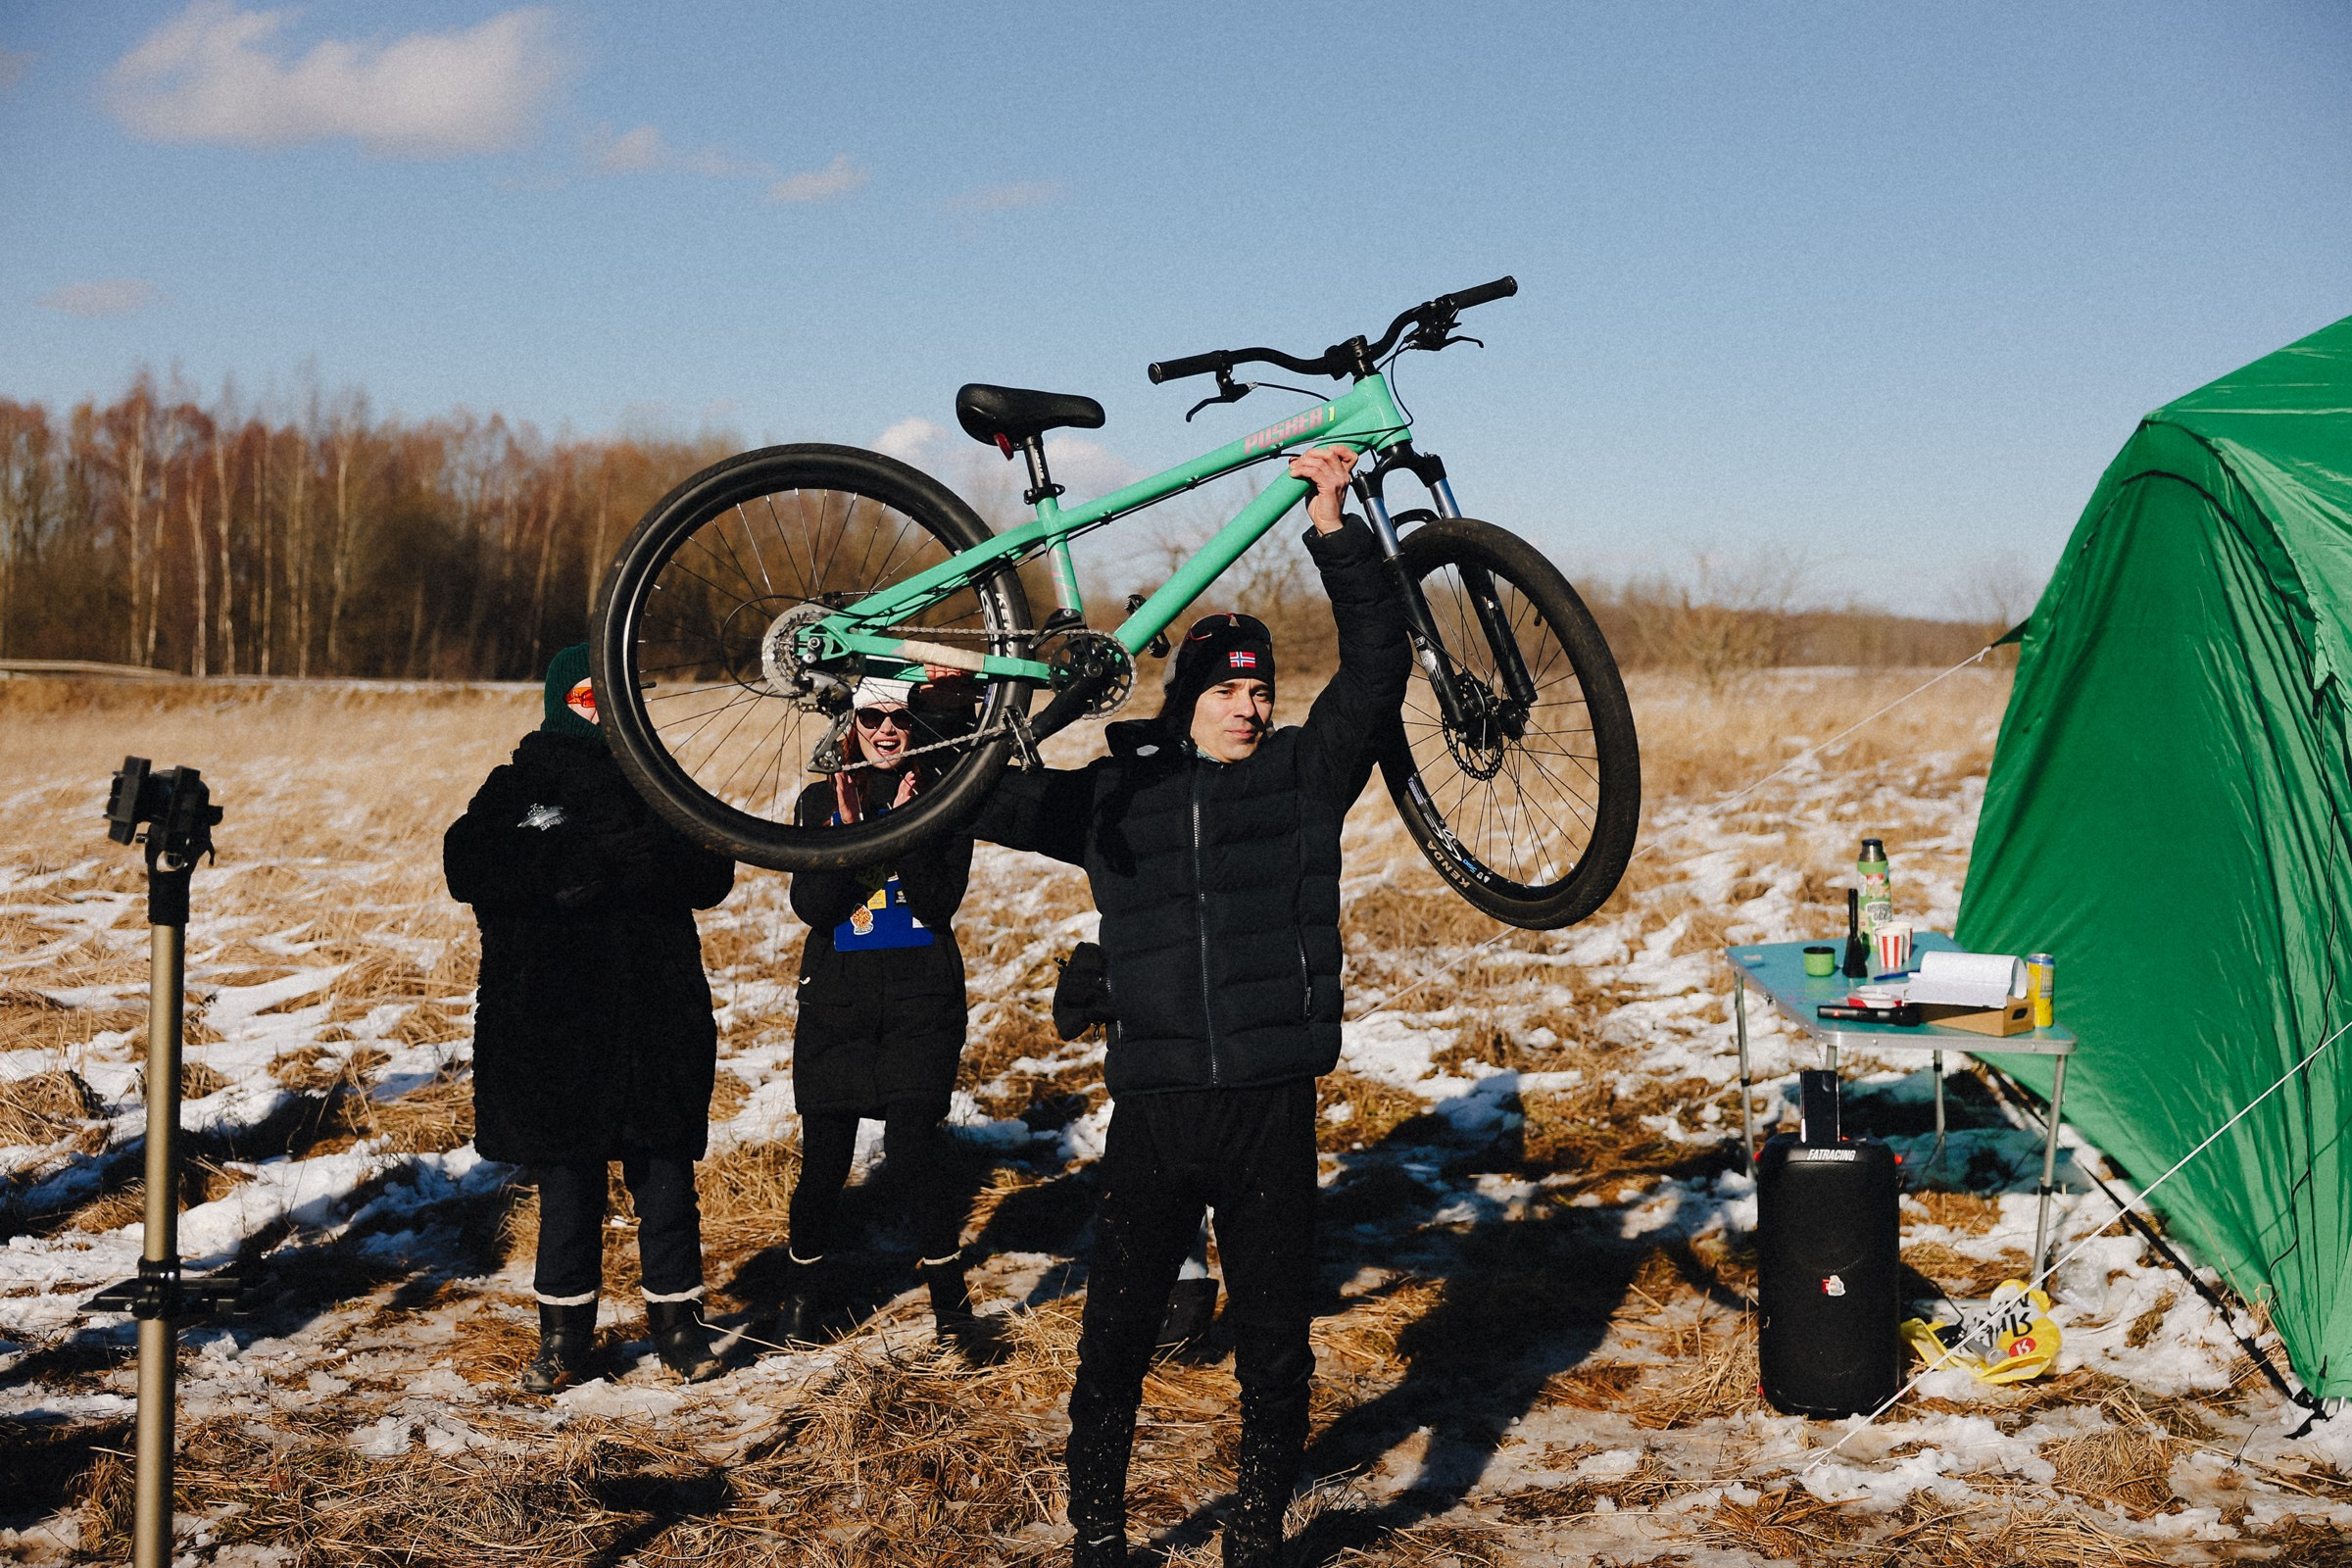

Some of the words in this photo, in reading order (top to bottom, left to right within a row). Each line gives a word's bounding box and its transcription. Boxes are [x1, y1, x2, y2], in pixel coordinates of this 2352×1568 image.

[1244, 407, 1323, 455] PUSHER
[1327, 406, 1335, 421] 1
[1427, 840, 1471, 889] KENDA
[1807, 1149, 1856, 1161] FATRACING
